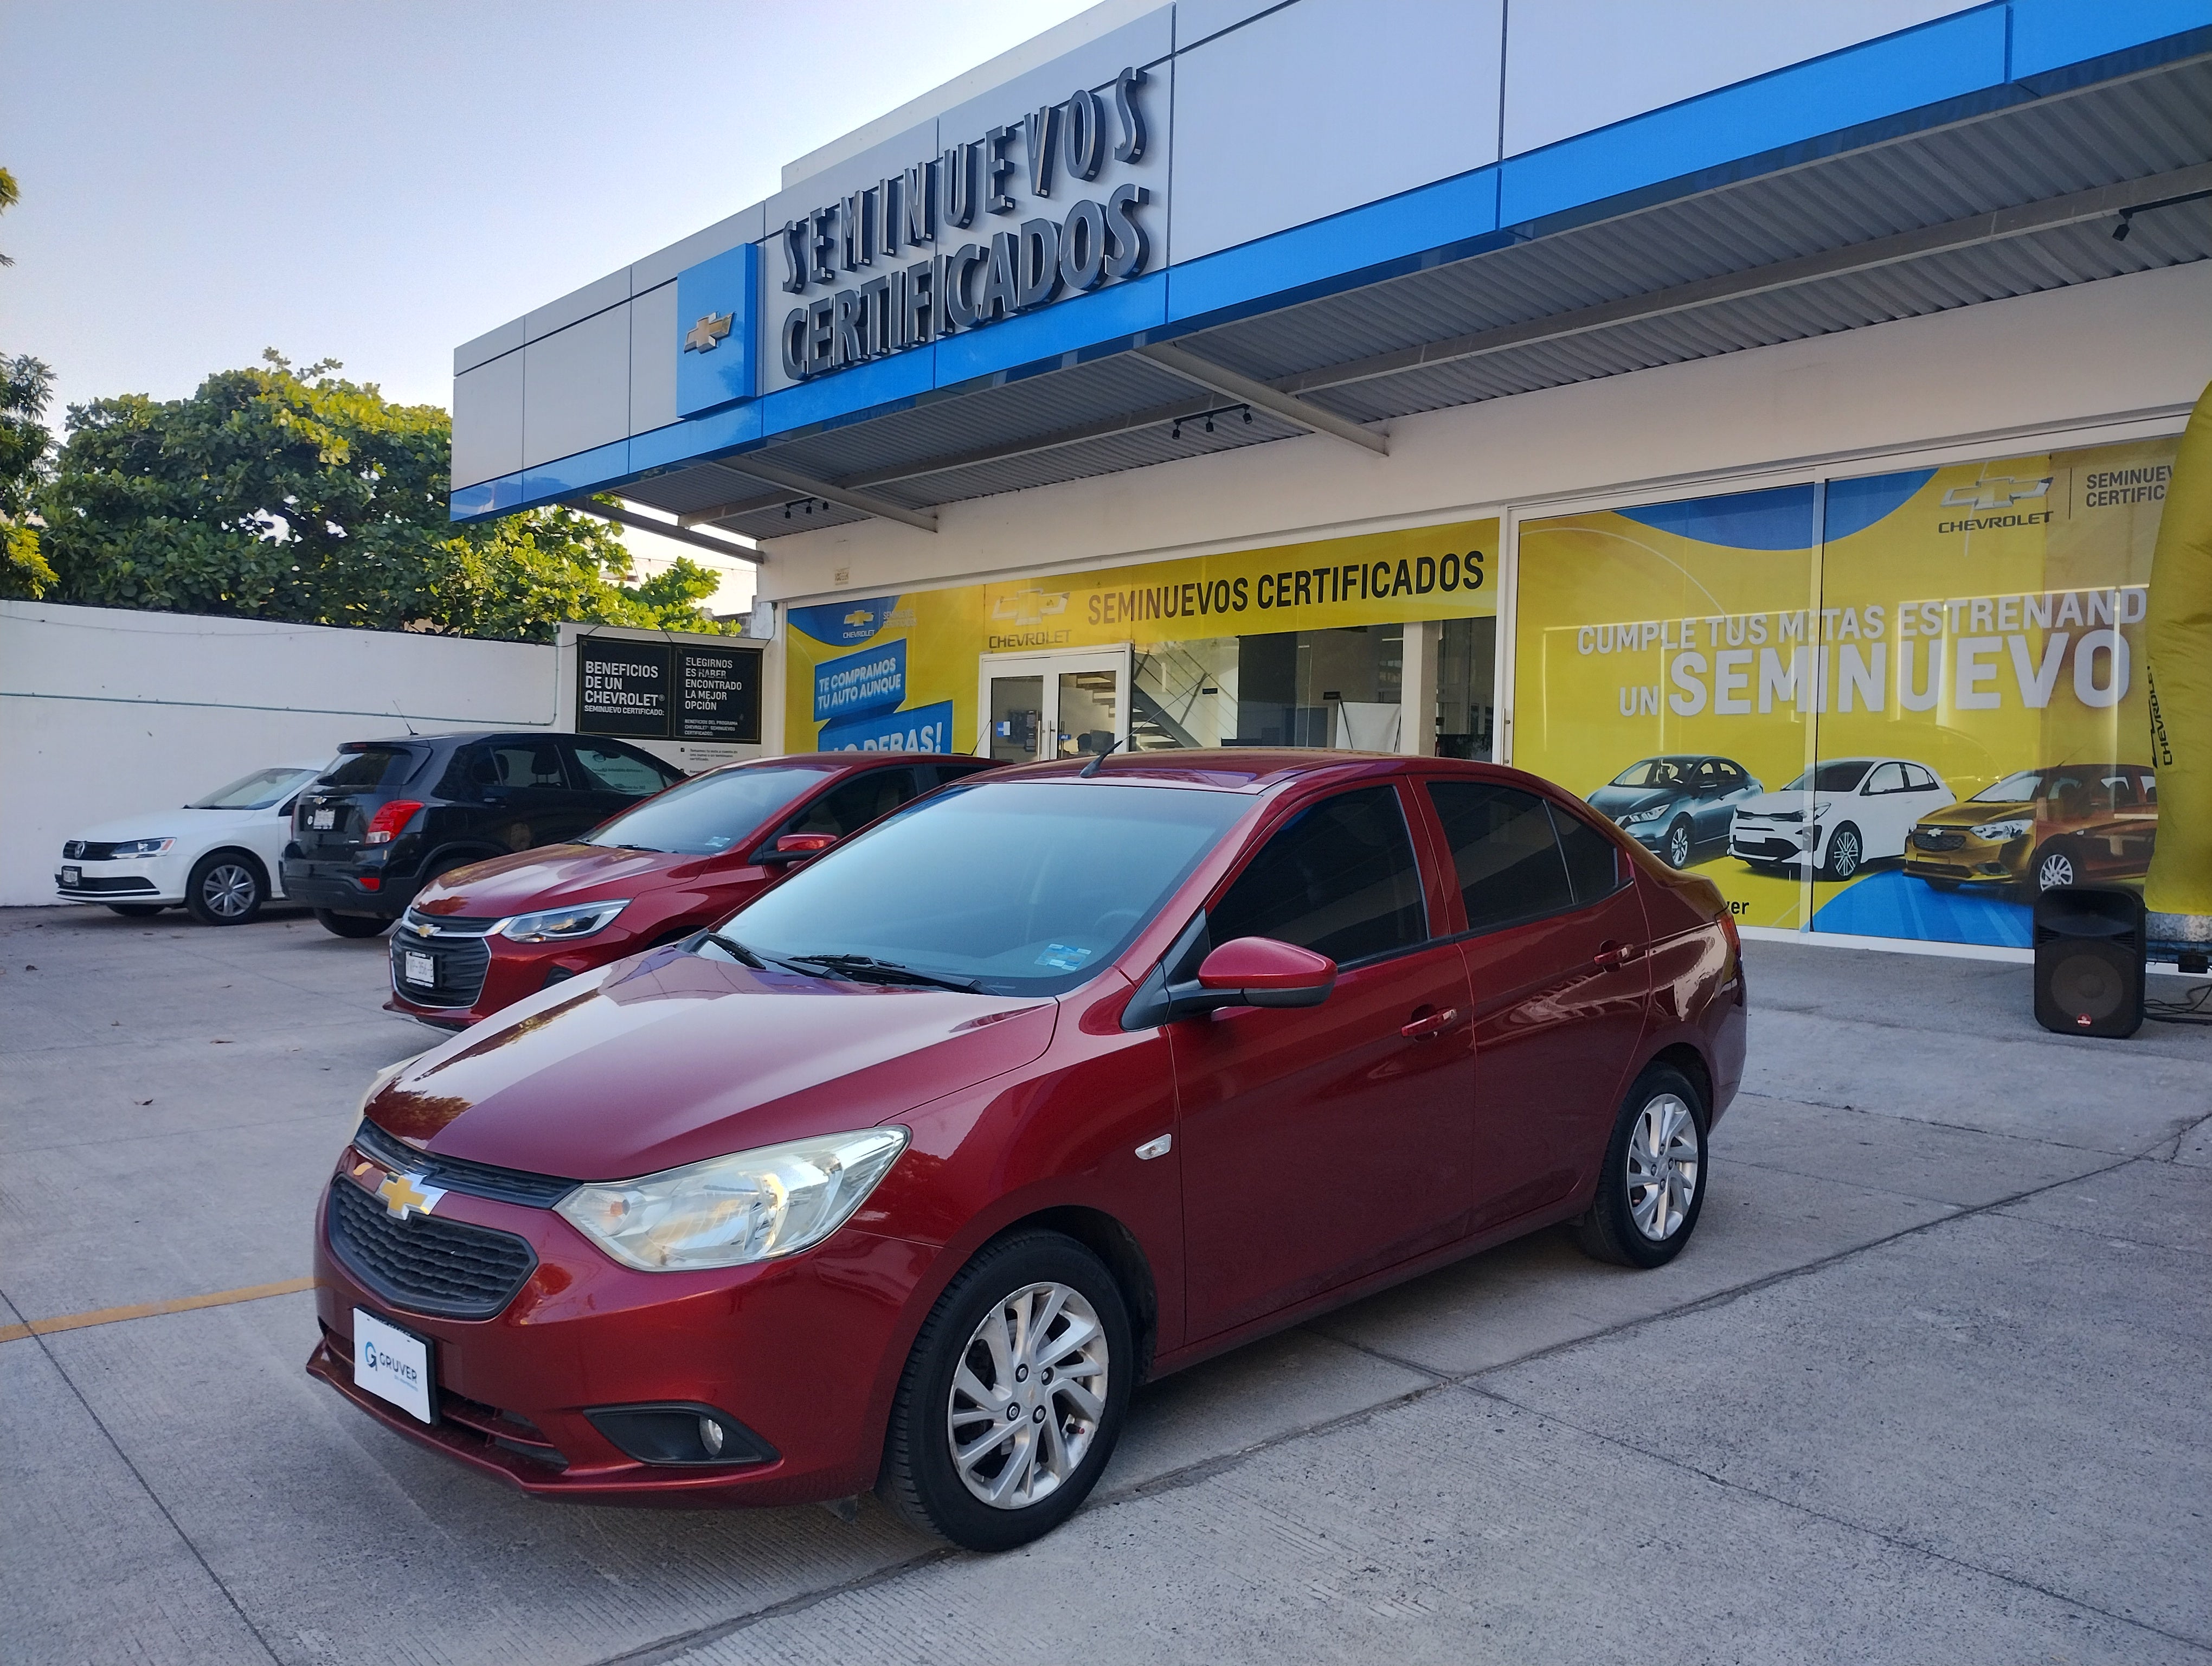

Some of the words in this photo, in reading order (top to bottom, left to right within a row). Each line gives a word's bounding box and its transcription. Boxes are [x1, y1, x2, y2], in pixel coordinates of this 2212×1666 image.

[782, 66, 1148, 294] SEMINUEVOS
[782, 183, 1150, 381] CERTIFICADOS
[2086, 485, 2165, 508] CERTIFIC
[1938, 511, 2054, 533] CHEVROLET
[1088, 577, 1249, 626] SEMINUEVOS
[1257, 550, 1484, 610] CERTIFICADOS
[1577, 619, 1696, 655] CUMPLE
[1705, 614, 1767, 647] TUS
[1778, 605, 1885, 643] METAS
[1899, 587, 2147, 637] ESTRENAND
[843, 630, 875, 639] CHEVROLET
[989, 629, 1072, 649] CHEVROLET
[585, 661, 658, 678] BENEFICIOS
[685, 657, 732, 669] ELEGIRNOS
[685, 668, 697, 677] ES
[698, 669, 726, 679] HABER
[1619, 685, 1658, 716] UN
[1668, 629, 2131, 717] SEMINUEVO
[586, 675, 602, 689] DE
[605, 677, 622, 690] UN
[685, 679, 742, 690] ENCONTRADO
[819, 677, 829, 692] TE
[831, 657, 896, 689] COMPRAMOS
[685, 690, 697, 699] LA
[698, 690, 728, 701] MEJOR
[818, 694, 830, 710] TU
[832, 686, 858, 706] AUTO
[859, 674, 902, 699] AUNQUE
[584, 705, 622, 714] SEMINUEVO
[685, 699, 717, 710] OPCIÓN
[2147, 666, 2172, 766] CHEVROLE
[380, 1351, 417, 1384] GRUVER
